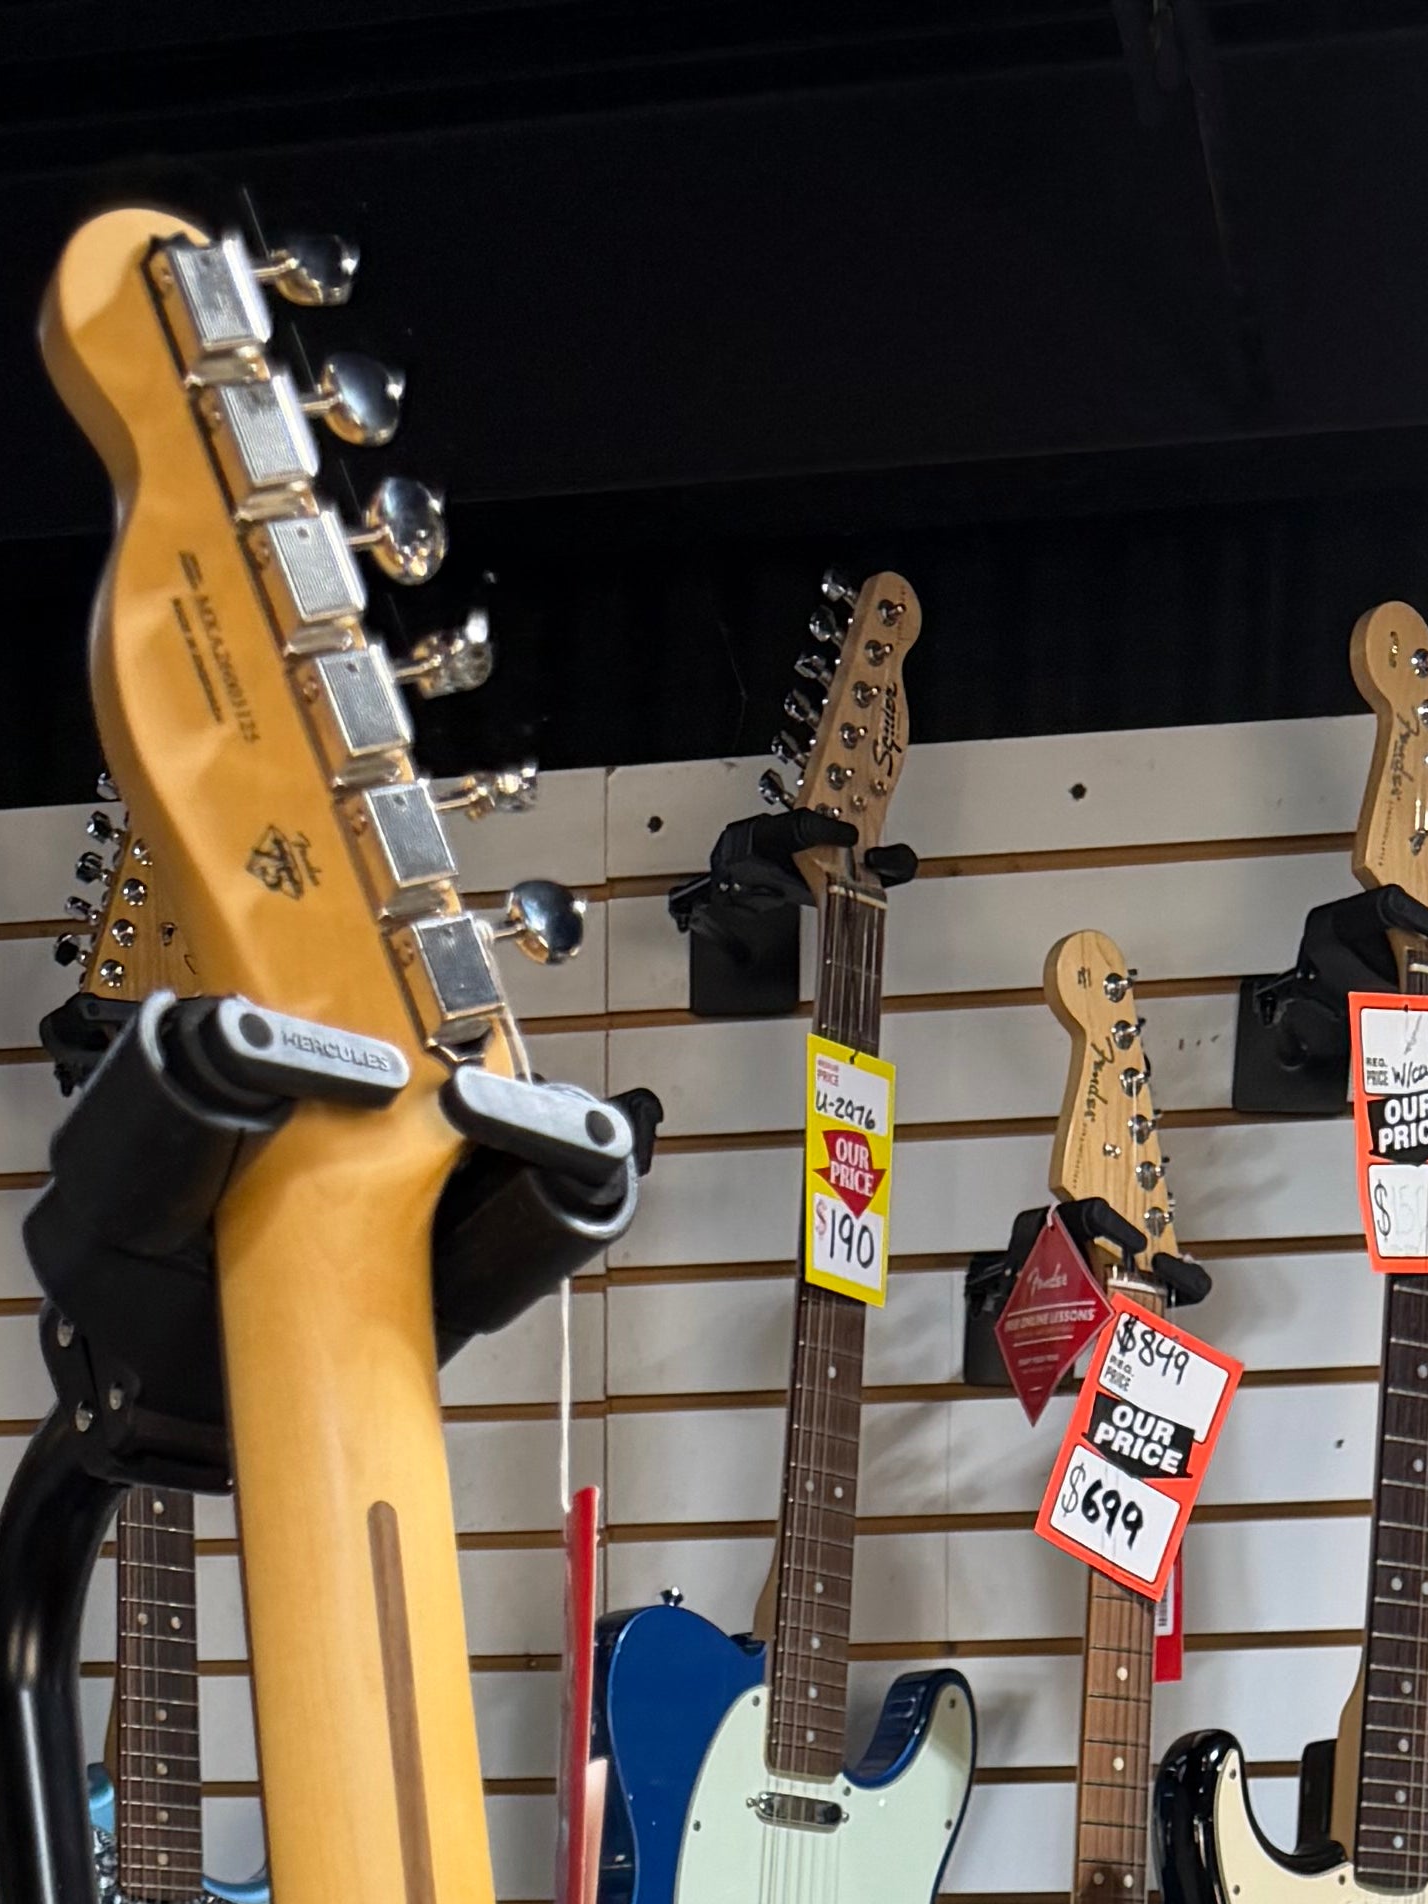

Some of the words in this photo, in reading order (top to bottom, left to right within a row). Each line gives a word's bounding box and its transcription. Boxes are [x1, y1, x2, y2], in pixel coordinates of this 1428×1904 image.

[873, 682, 902, 778] Squier
[280, 1028, 390, 1072] HERCULES
[817, 1068, 839, 1088] PRICE
[1084, 1036, 1116, 1123] Fender
[1366, 1070, 1389, 1086] PRICE
[835, 1137, 870, 1171] OUR
[830, 1160, 875, 1198] PRICE
[815, 1198, 875, 1270] $190
[1049, 1308, 1096, 1325] LESSONS
[1112, 1405, 1175, 1446] OUR
[1094, 1421, 1183, 1475] PRICE
[1061, 1462, 1144, 1550] $699
